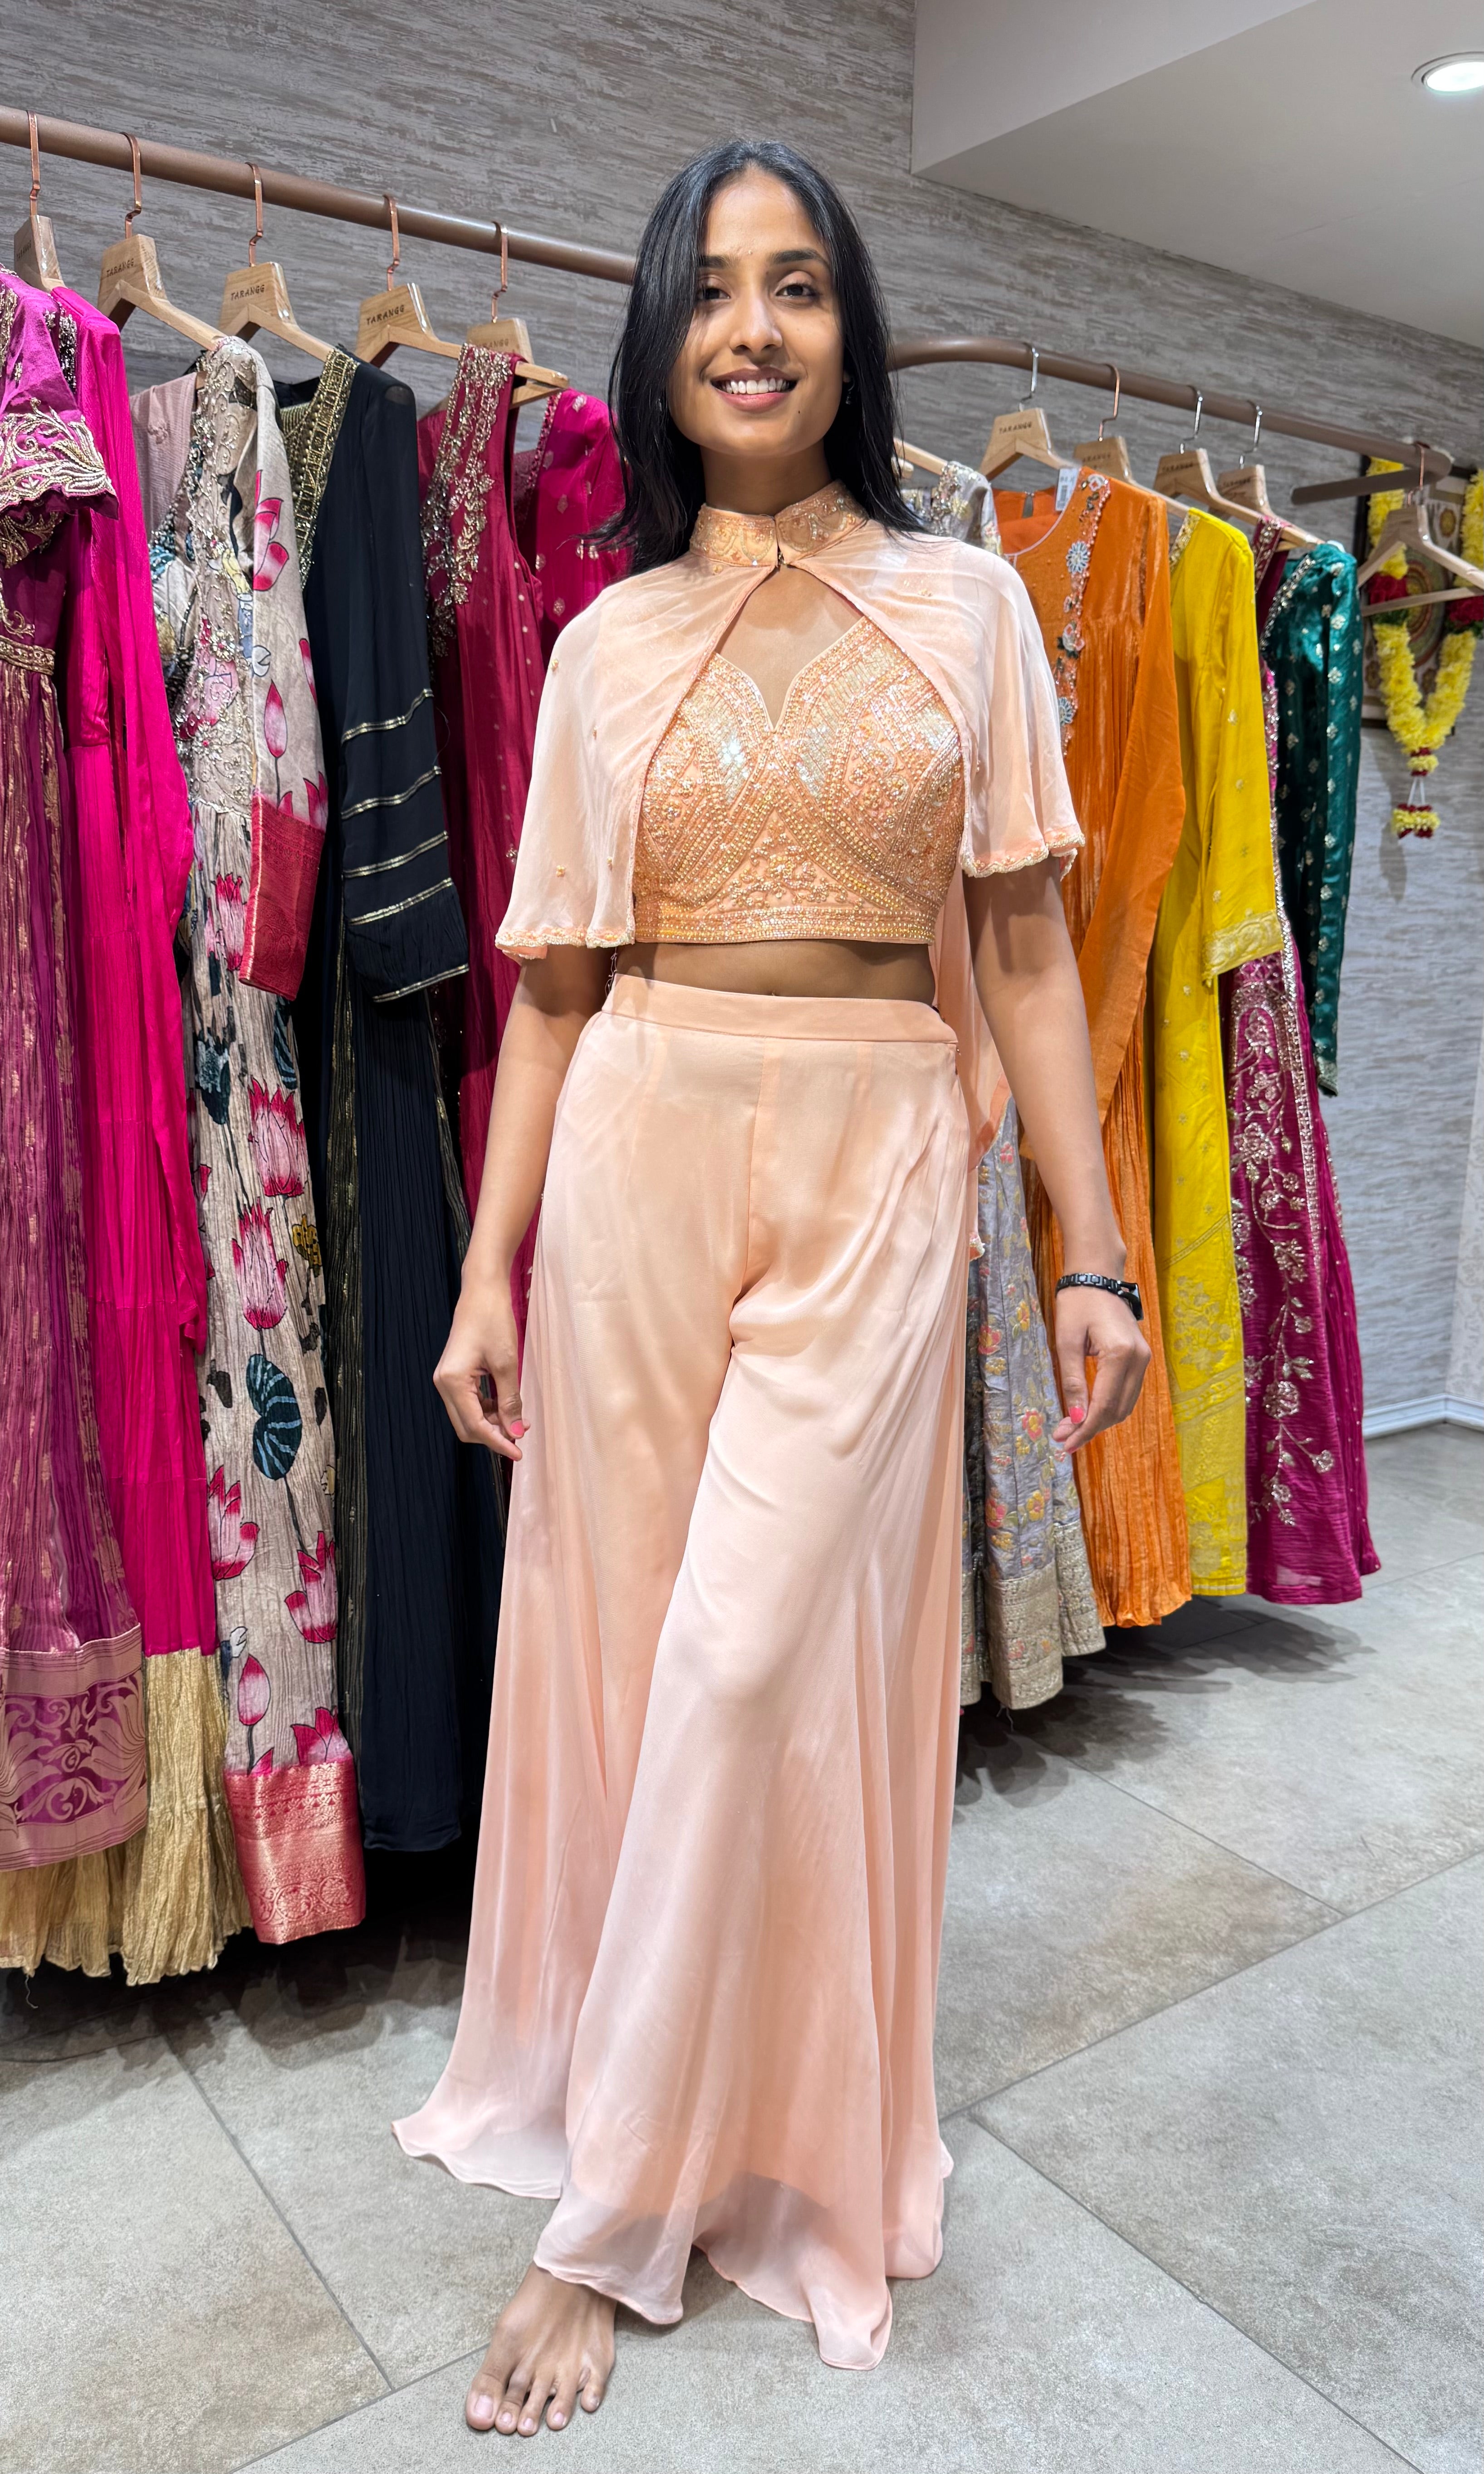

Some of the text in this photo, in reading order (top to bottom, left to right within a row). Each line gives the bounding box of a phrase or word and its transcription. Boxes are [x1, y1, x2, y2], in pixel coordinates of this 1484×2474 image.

[107, 258, 134, 277] TARANGG
[231, 284, 264, 301] TARANGG
[367, 304, 404, 325] TARANGG
[999, 421, 1032, 434] TARANGG
[1082, 452, 1111, 463] ARANGG
